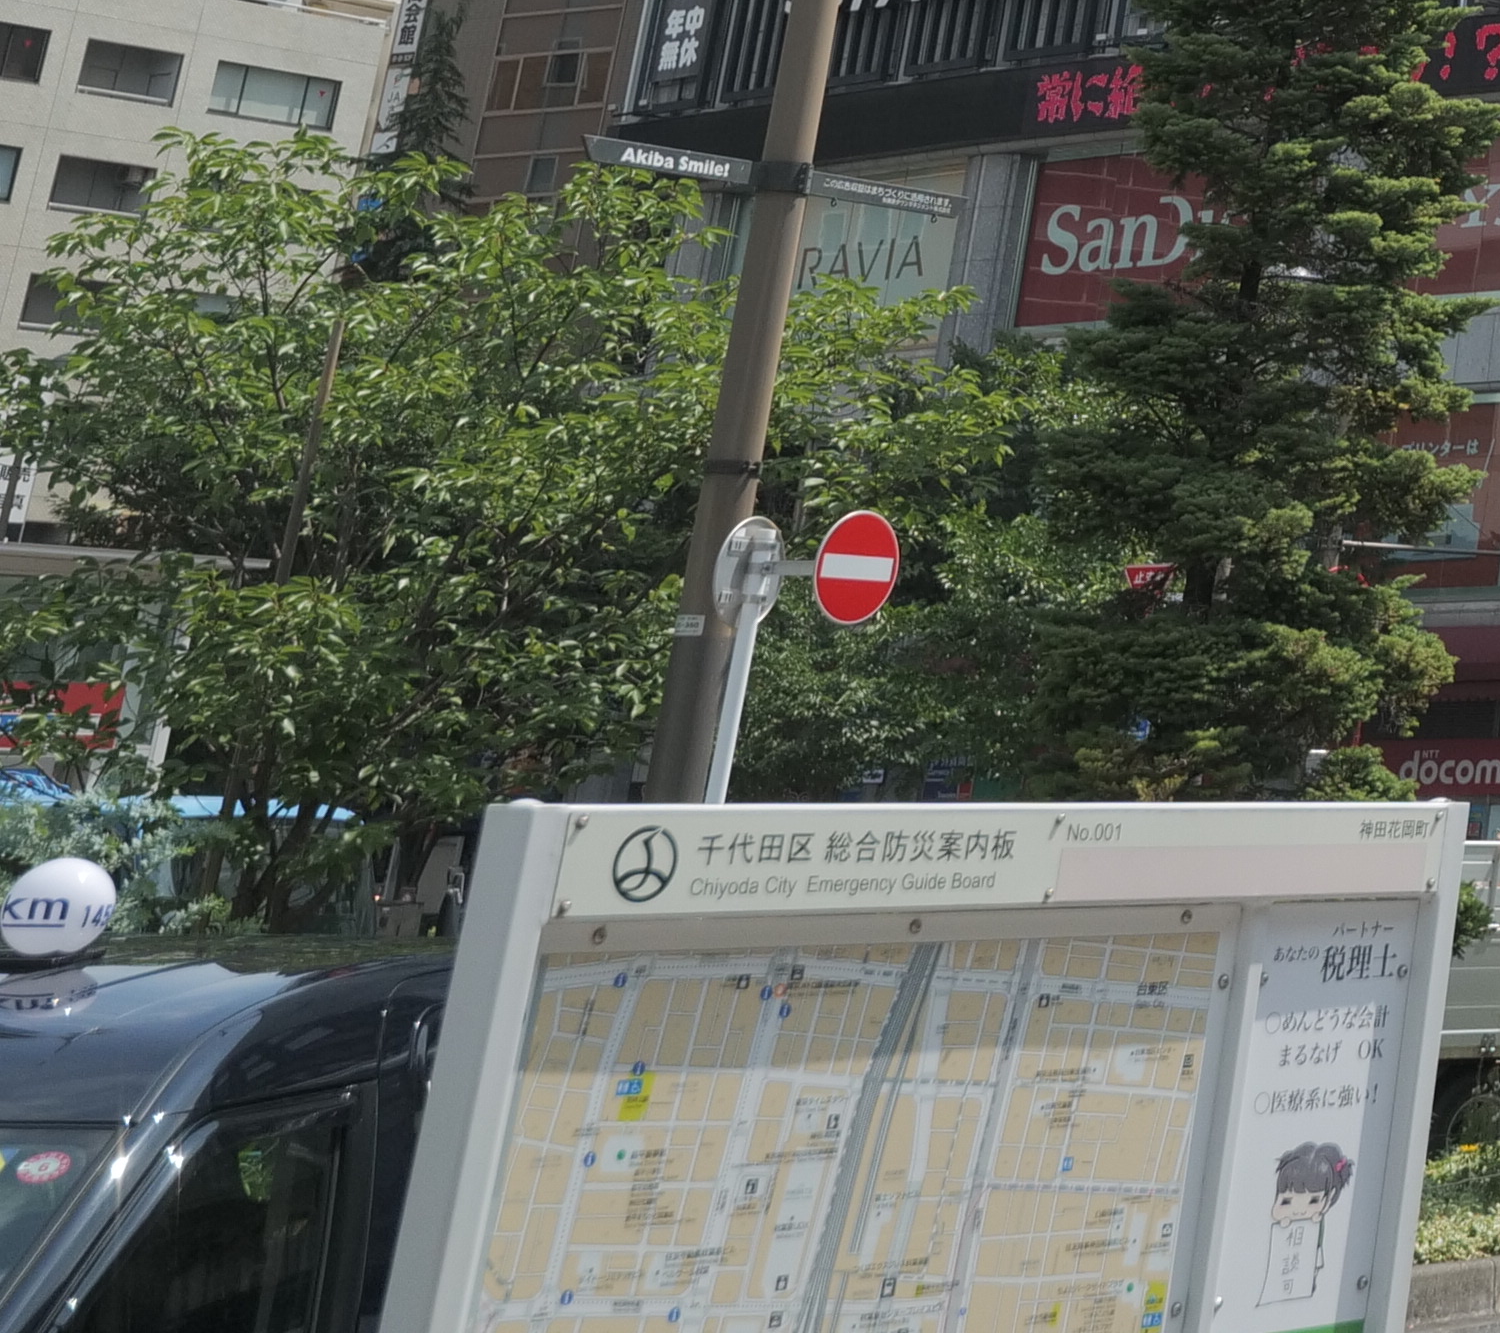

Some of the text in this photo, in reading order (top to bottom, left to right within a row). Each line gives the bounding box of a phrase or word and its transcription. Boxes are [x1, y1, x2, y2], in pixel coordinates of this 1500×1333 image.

[665, 6, 705, 38] 年中
[658, 37, 699, 71] 無休
[620, 146, 730, 178] Akiba Smile!
[1066, 823, 1122, 843] No.001
[1358, 820, 1429, 840] 神田花岡町
[697, 829, 1015, 866] 千代田区 総合防災案内板
[689, 871, 996, 898] Chiyoda City Emergency Guide Board
[1332, 921, 1394, 937] パートナー
[1273, 945, 1320, 962] あなたの
[1278, 1042, 1383, 1067] まるなげ OK
